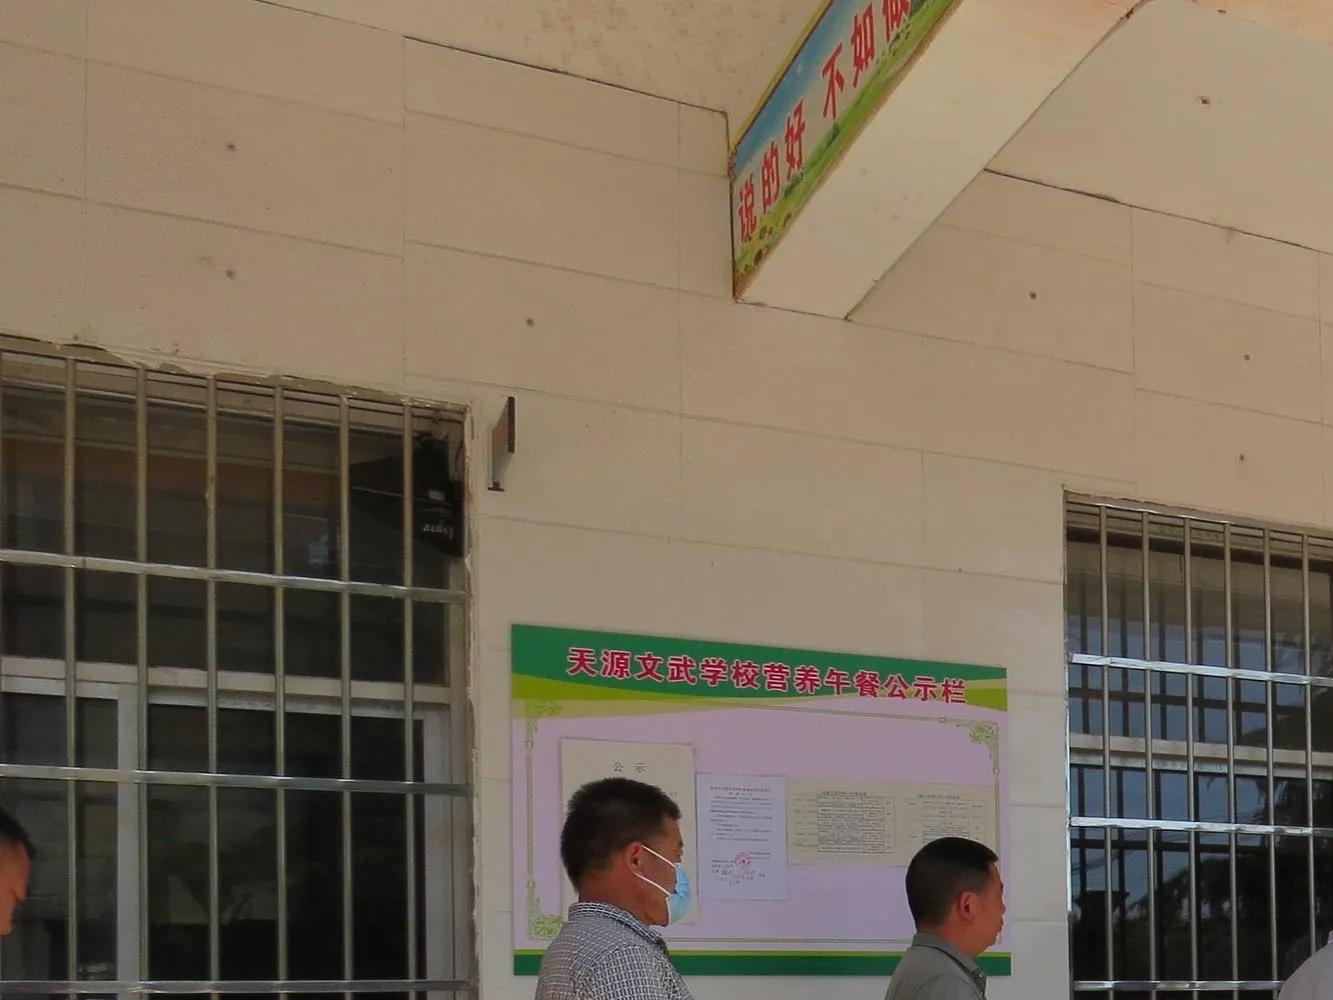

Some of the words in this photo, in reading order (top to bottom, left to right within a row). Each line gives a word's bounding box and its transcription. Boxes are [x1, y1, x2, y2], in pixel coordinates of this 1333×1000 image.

[566, 646, 967, 705] 天源文武学校营养午餐公示栏
